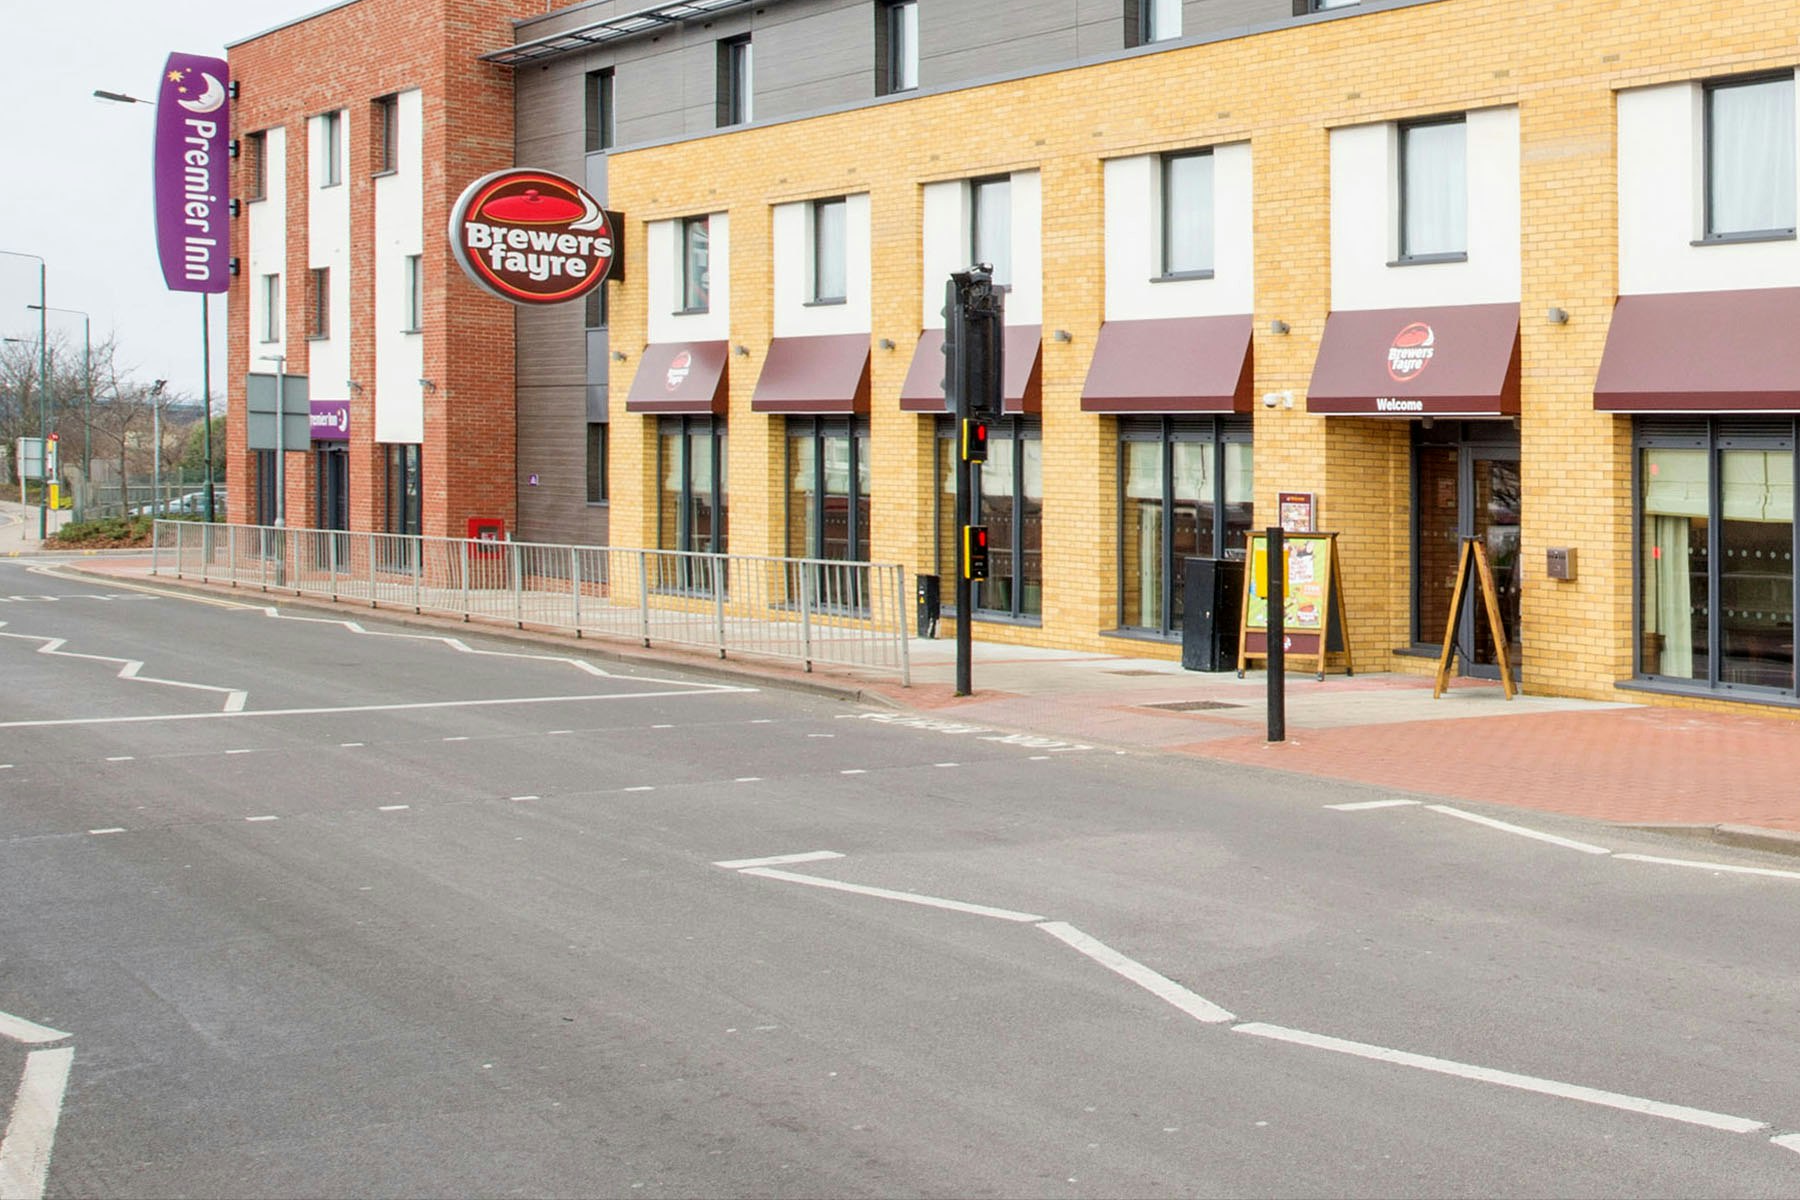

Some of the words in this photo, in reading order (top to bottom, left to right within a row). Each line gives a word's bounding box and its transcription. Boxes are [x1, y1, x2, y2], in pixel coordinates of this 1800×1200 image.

[184, 118, 218, 233] Premier
[465, 221, 613, 257] Brewers
[184, 236, 217, 281] Inn
[488, 243, 587, 282] fayre
[1388, 347, 1434, 360] Brewers
[1376, 397, 1423, 411] Welcome
